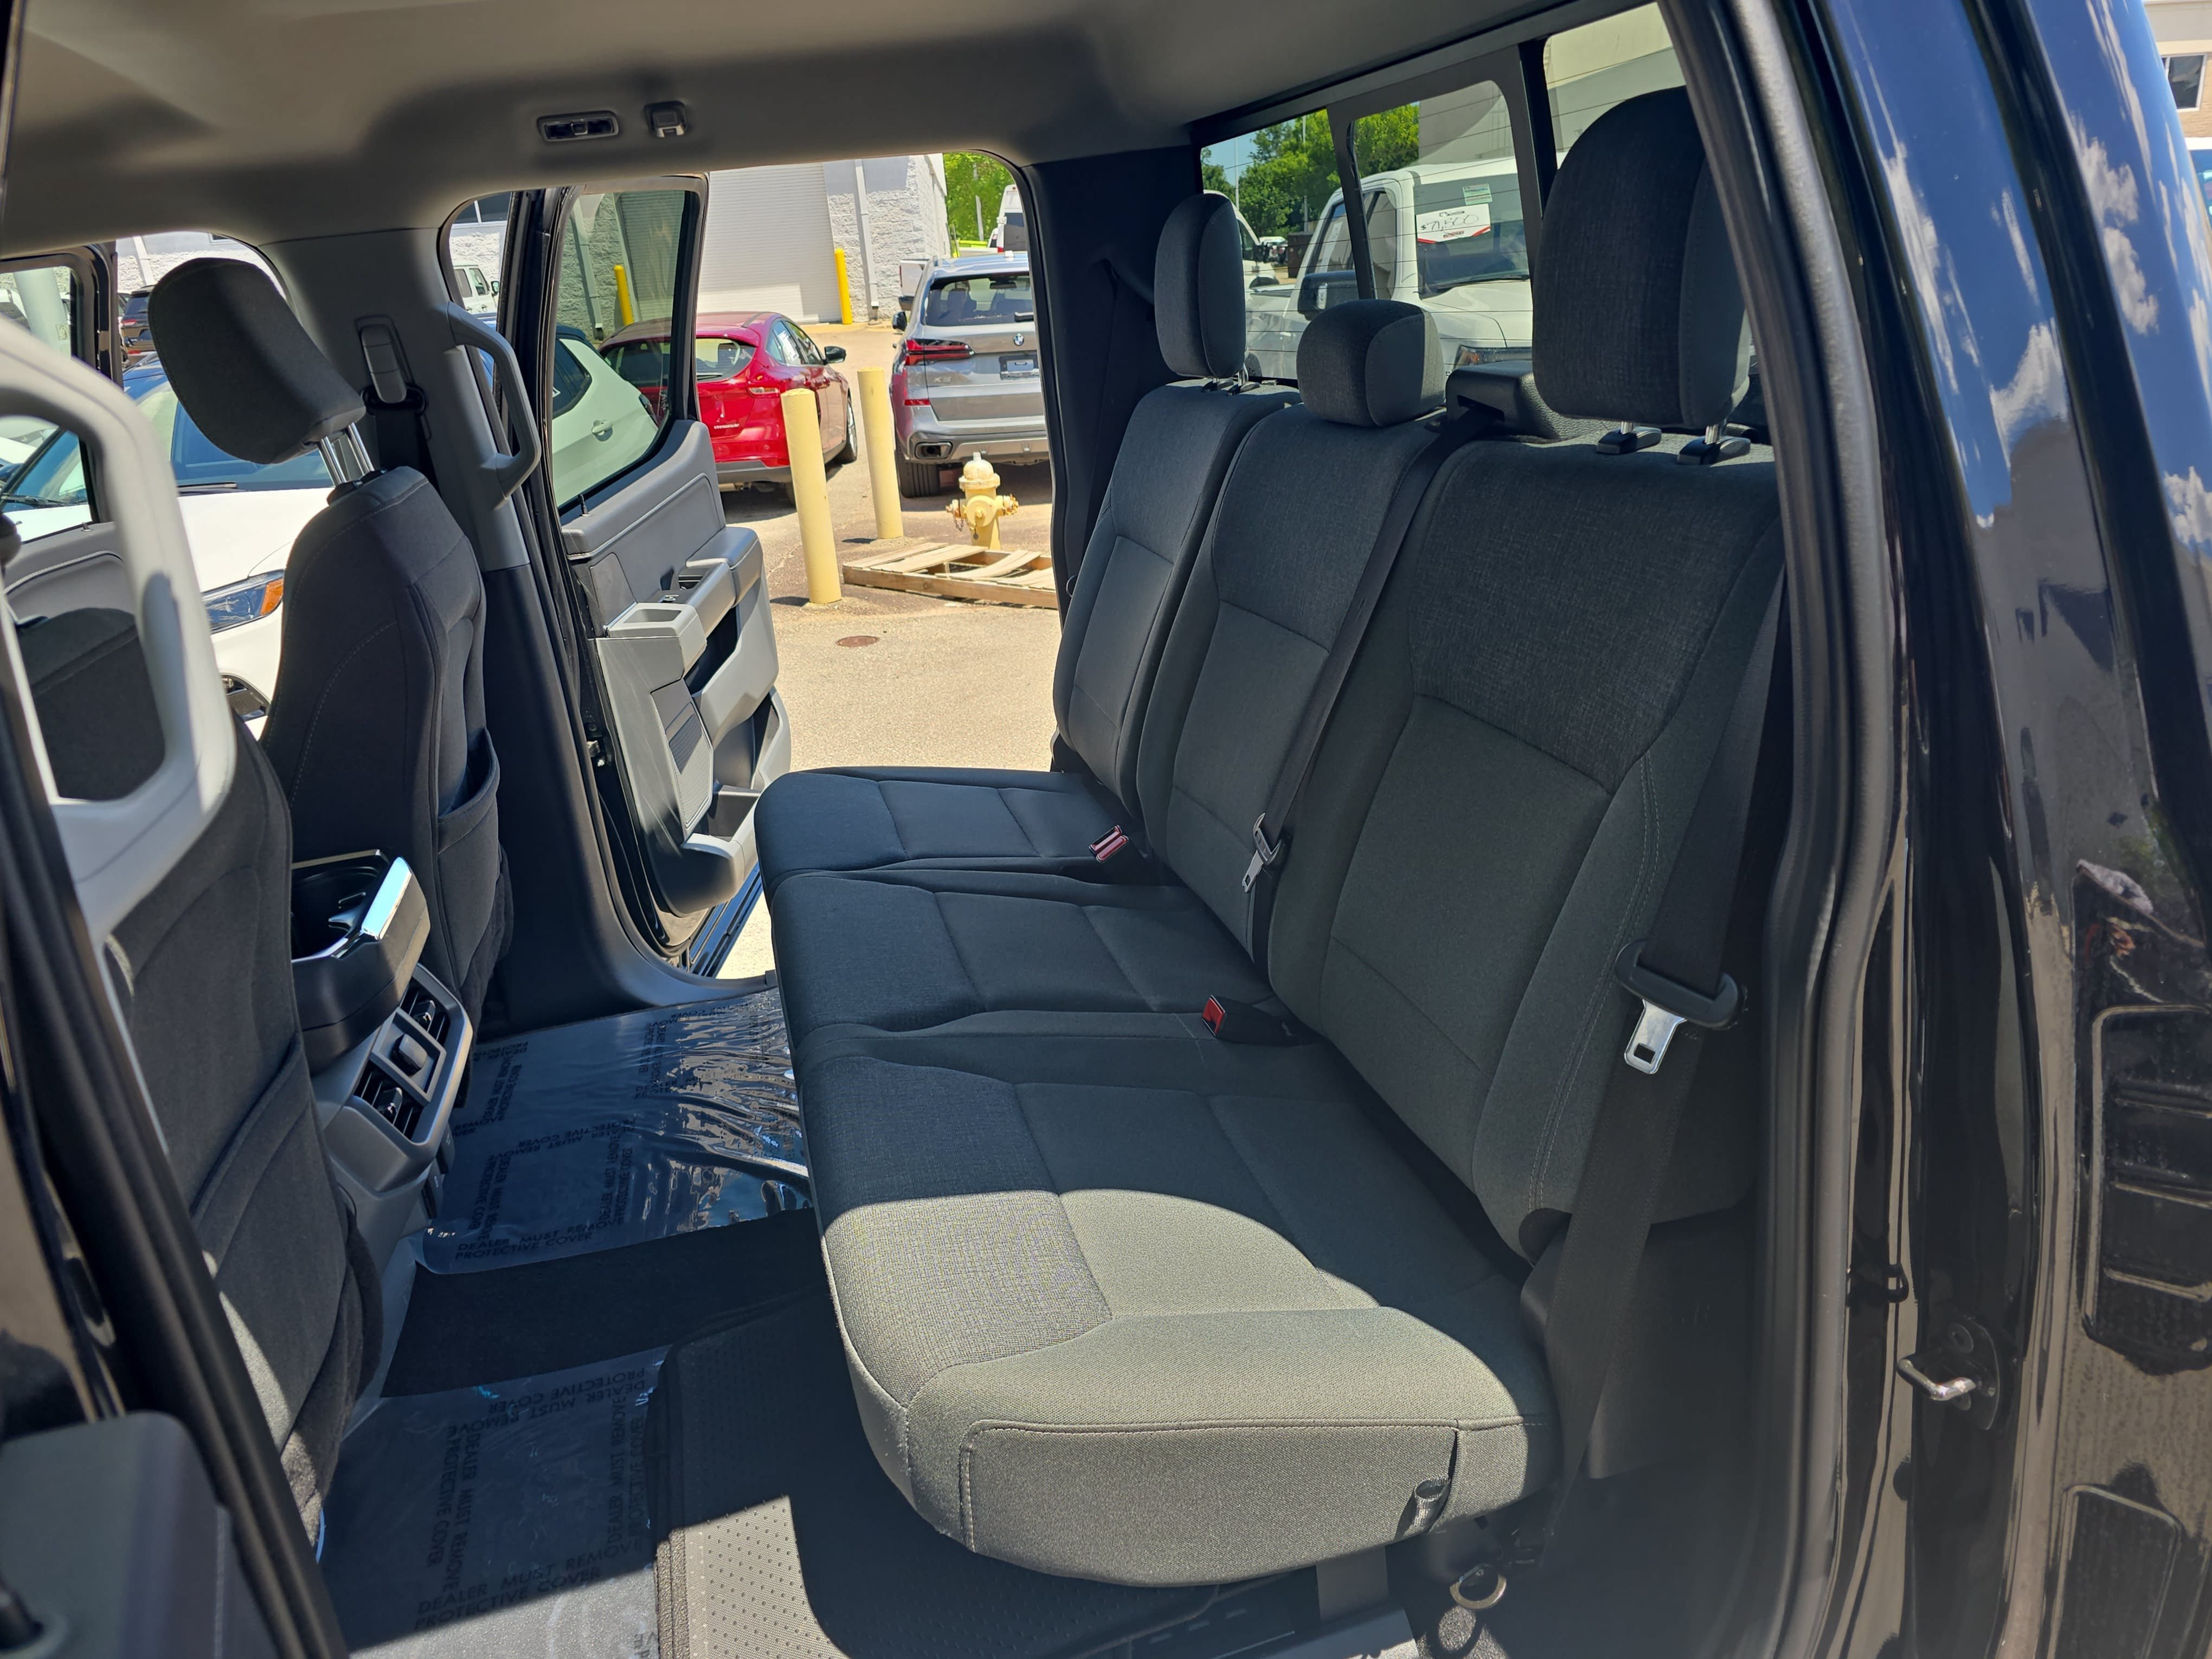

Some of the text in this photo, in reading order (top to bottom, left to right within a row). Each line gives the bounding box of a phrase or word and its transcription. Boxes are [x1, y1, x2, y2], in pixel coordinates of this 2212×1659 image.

[518, 1134, 560, 1148] COVER
[455, 1231, 594, 1260] PROTECTIVE COVER
[457, 1219, 624, 1252] DEALER MUST REMOVE
[446, 1380, 645, 1437] DEALER MUST REMOVE
[489, 1368, 645, 1414] PROTECTIVE COVER
[608, 1396, 626, 1545] DEALER MUST REMOVE
[628, 1416, 644, 1538] PROTECTIVE COVER
[427, 1438, 461, 1568] PROTECTIVE COVER
[443, 1433, 480, 1594] DEALER MUST REMOVE
[414, 1566, 603, 1631] PROTECTIVE COVER
[417, 1583, 487, 1615] DEALER
[501, 1563, 555, 1590] MUST
